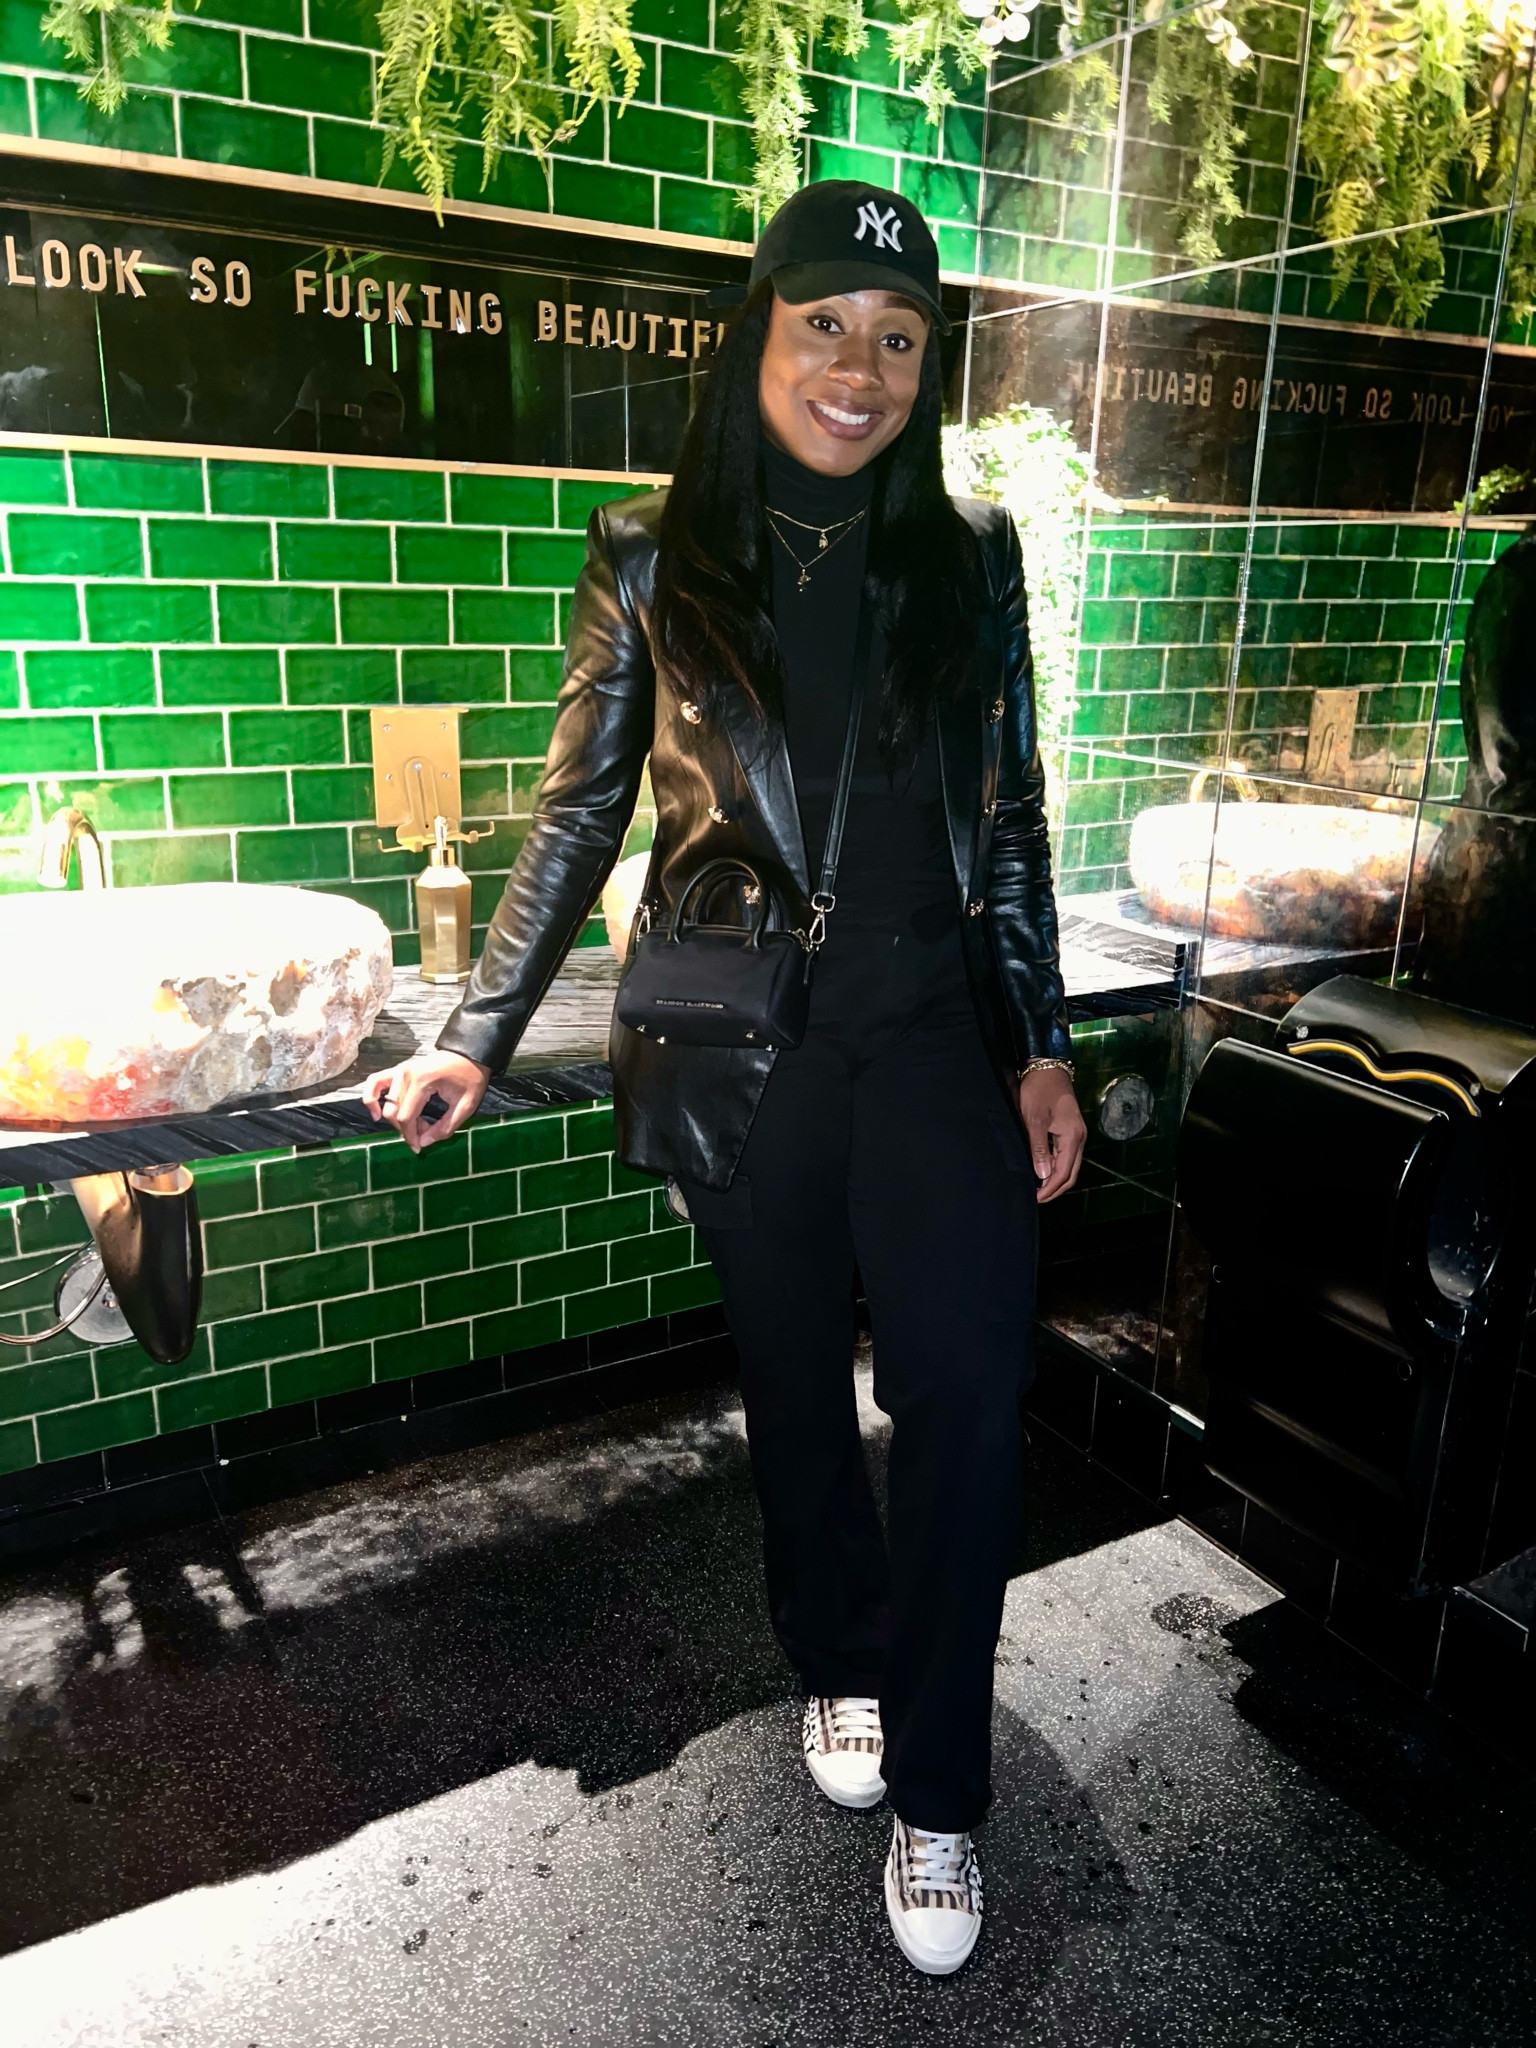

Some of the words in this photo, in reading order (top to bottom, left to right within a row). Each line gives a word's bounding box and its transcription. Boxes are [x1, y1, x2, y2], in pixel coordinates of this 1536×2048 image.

[853, 201, 903, 252] NY
[5, 235, 147, 298] LOOK
[190, 256, 251, 307] SO
[295, 269, 502, 336] FUCKING
[537, 299, 726, 358] BEAUTIF
